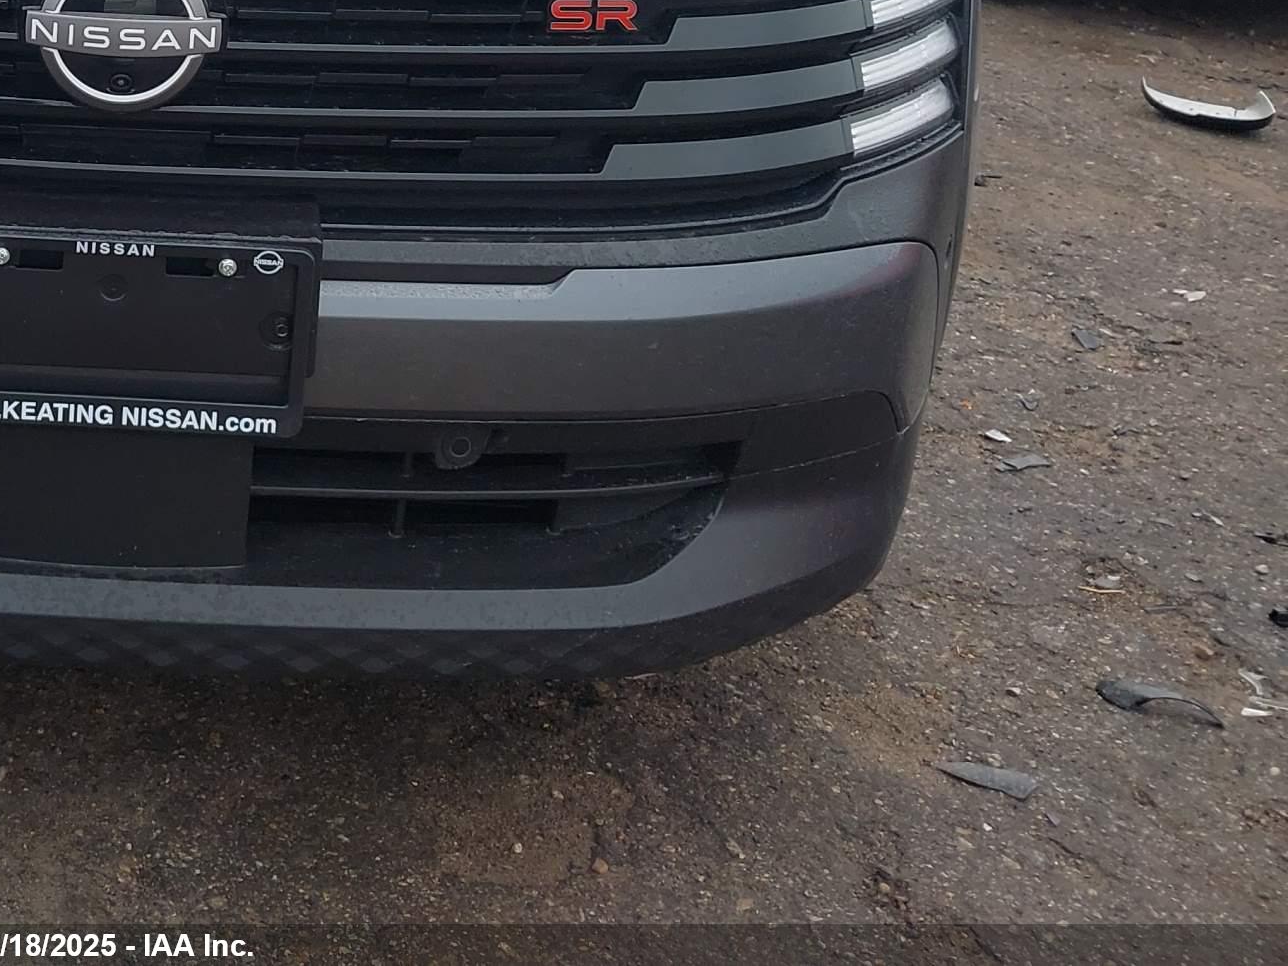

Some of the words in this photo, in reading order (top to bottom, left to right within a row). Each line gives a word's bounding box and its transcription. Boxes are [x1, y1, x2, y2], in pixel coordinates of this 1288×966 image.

[30, 18, 217, 51] NISSAN
[76, 240, 156, 257] NISSAN
[122, 406, 277, 434] NISSAN.com
